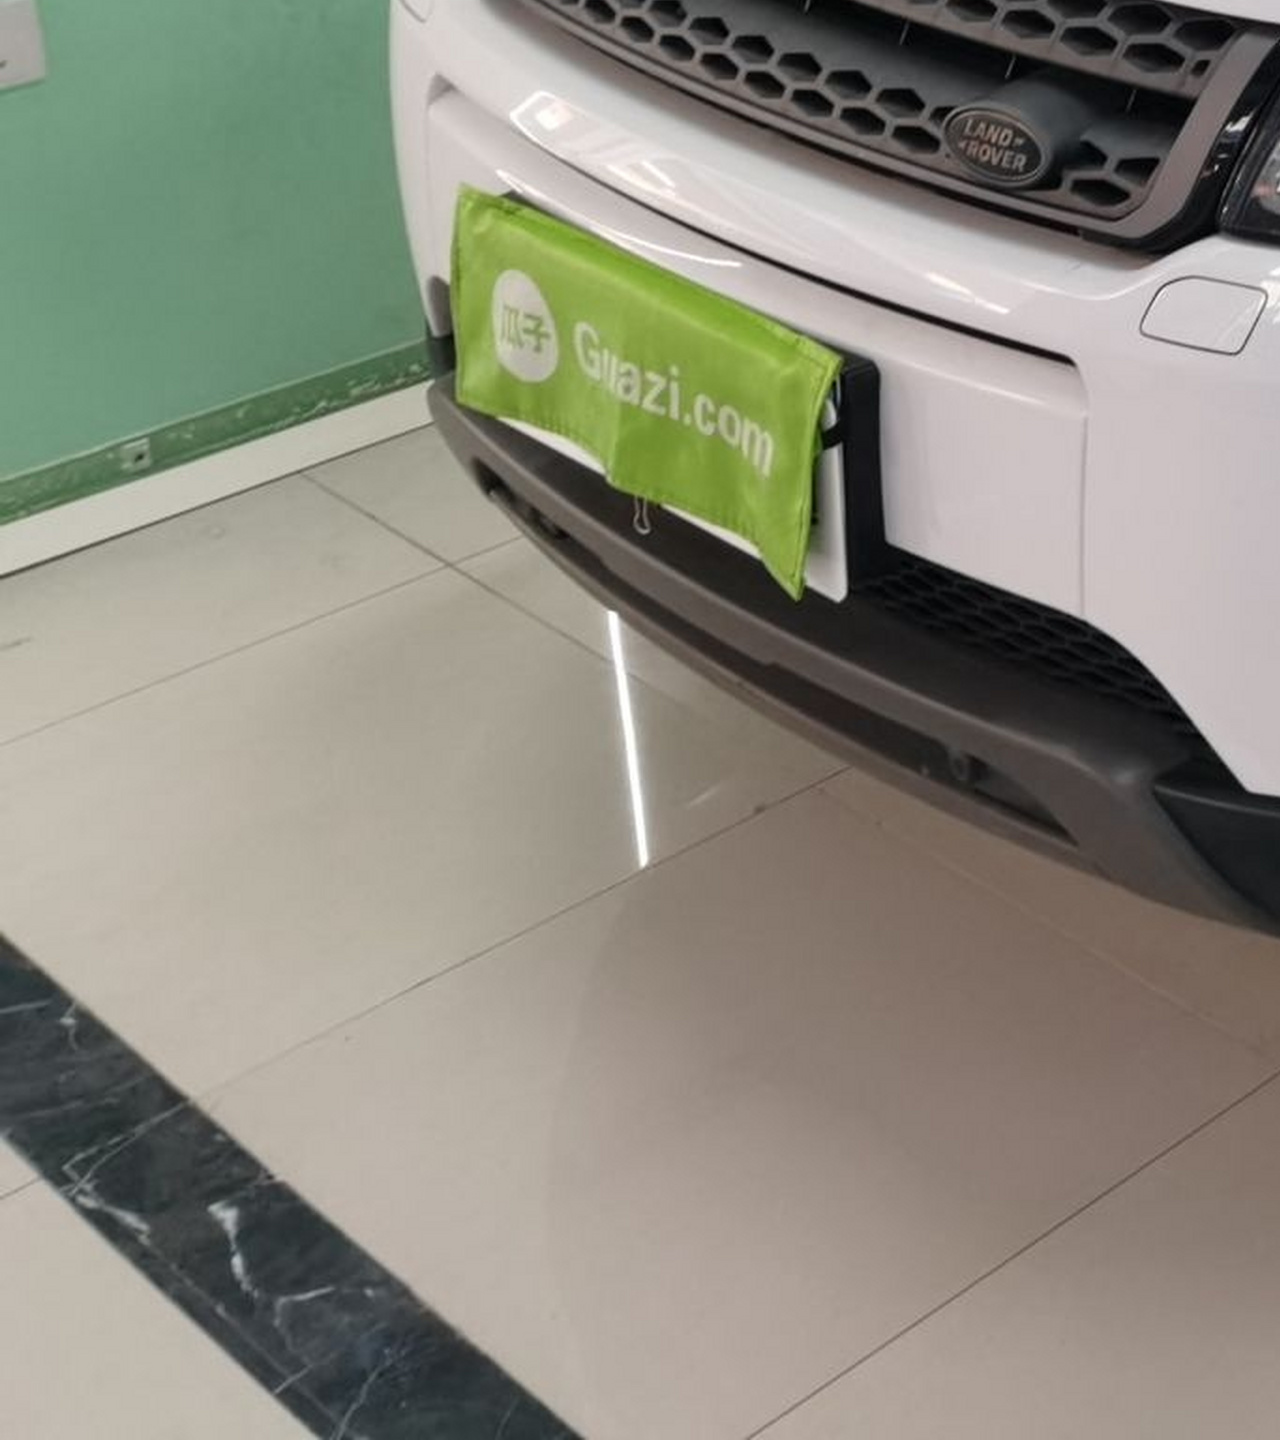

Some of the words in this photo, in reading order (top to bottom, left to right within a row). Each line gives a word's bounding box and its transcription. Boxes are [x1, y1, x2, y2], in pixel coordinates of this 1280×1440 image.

[962, 119, 1014, 147] LAND
[965, 140, 1028, 173] ROVER
[500, 304, 551, 353] 瓜子
[573, 320, 775, 480] Guazi.com
